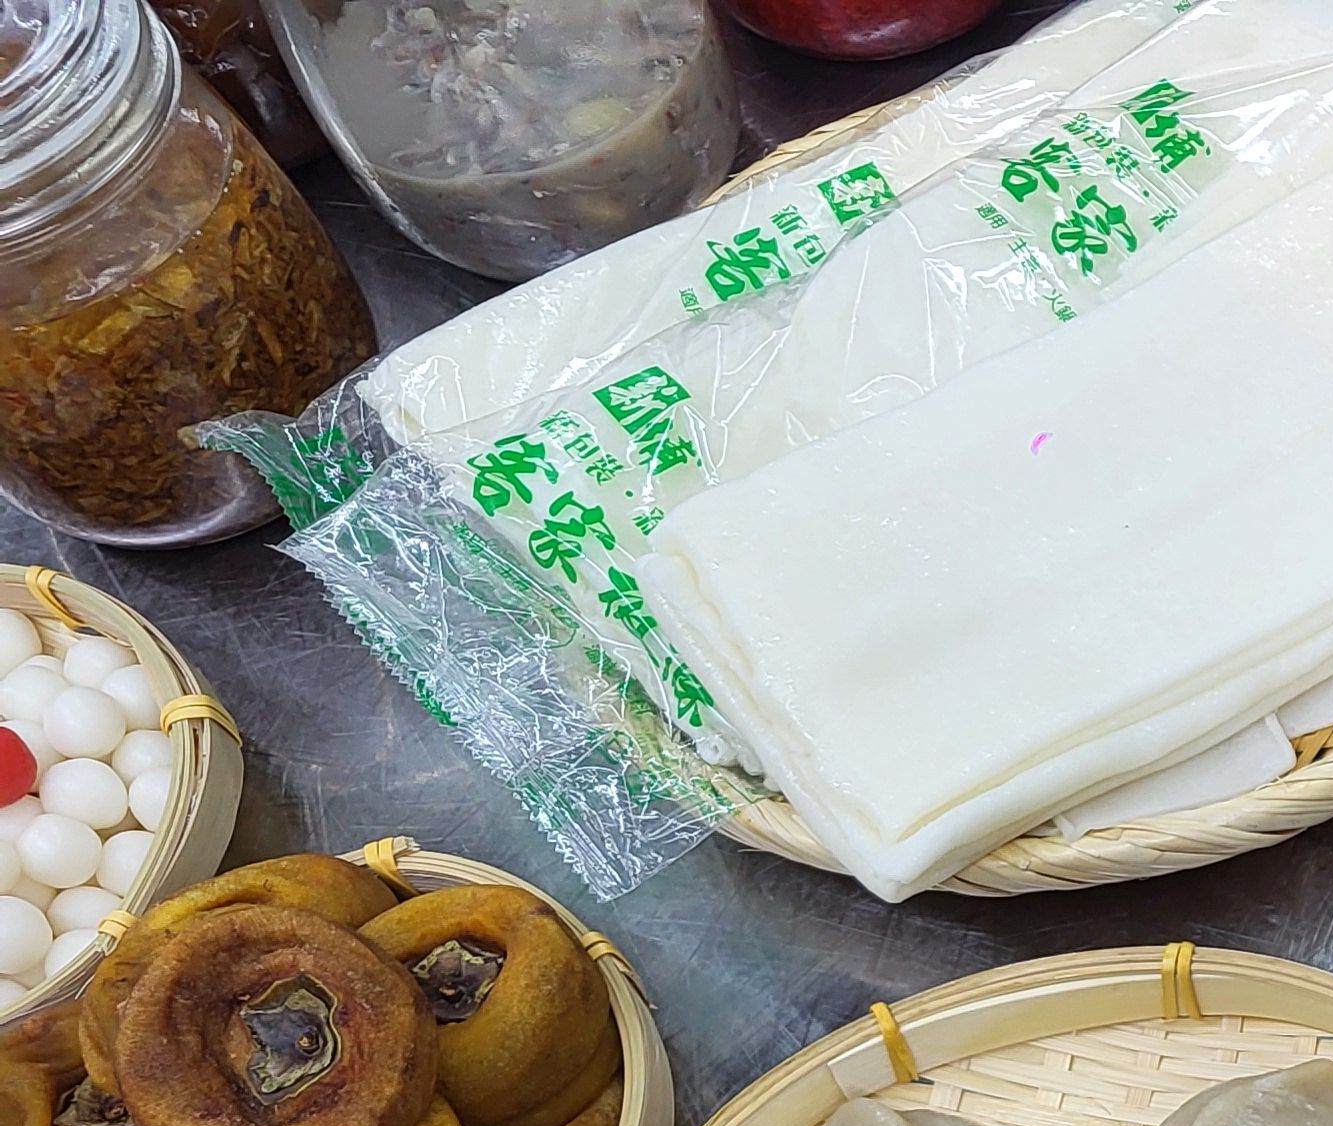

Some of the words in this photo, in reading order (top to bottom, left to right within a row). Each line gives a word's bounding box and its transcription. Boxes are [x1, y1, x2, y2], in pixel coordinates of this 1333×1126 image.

[769, 203, 827, 268] 新包
[1001, 137, 1138, 277] 客家
[706, 226, 791, 302] 客
